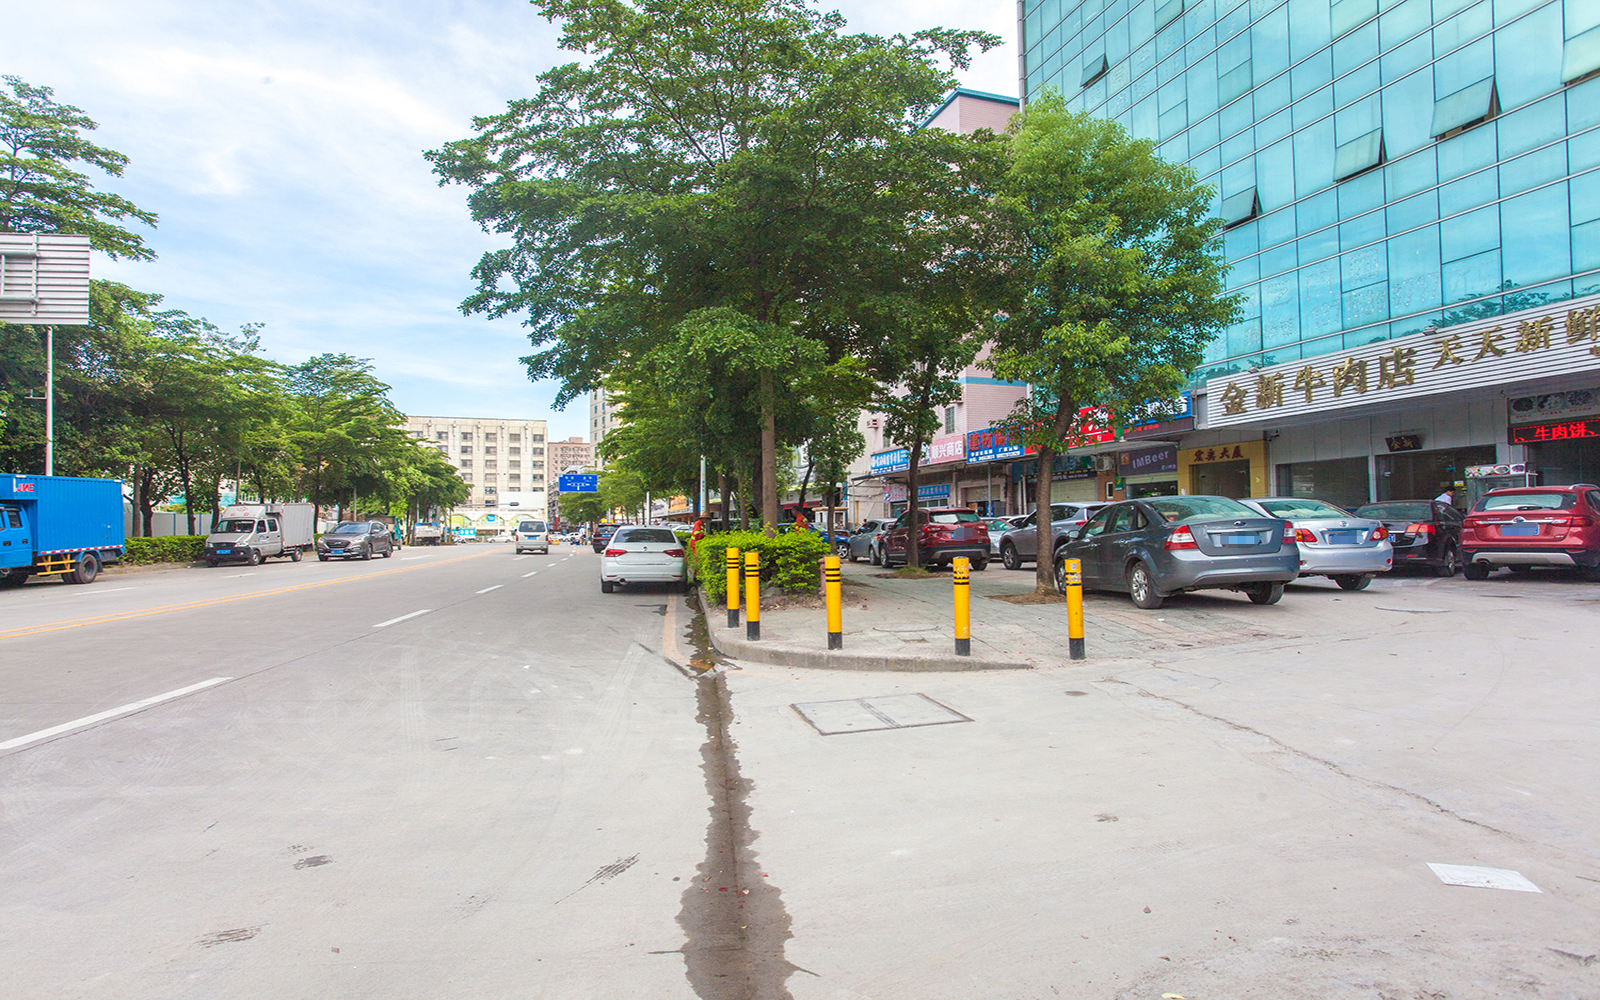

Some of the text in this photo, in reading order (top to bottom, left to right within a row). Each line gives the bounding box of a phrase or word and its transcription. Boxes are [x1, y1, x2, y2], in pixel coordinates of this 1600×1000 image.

[1220, 347, 1417, 415] 金新牛肉店
[931, 440, 963, 459] 顺兴商店
